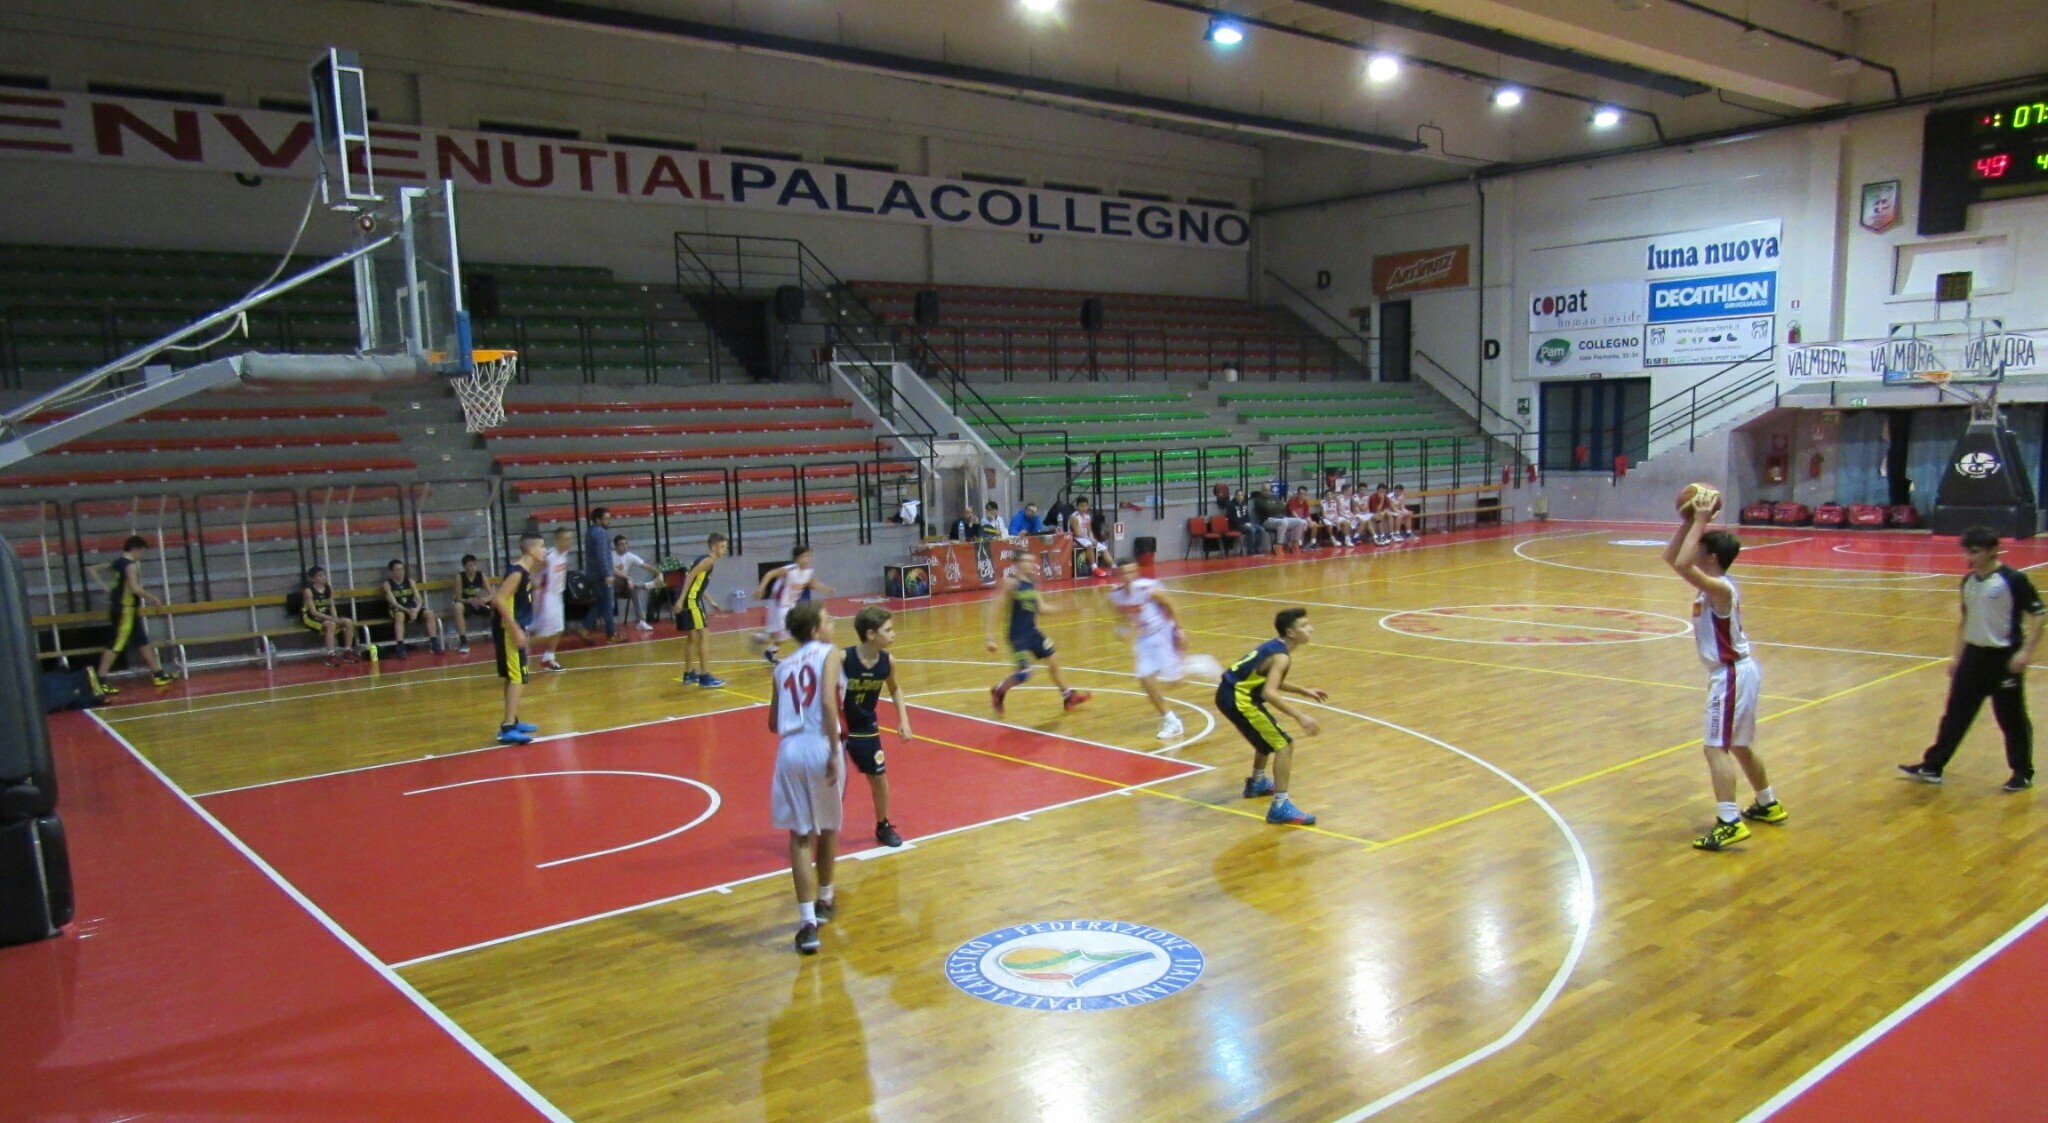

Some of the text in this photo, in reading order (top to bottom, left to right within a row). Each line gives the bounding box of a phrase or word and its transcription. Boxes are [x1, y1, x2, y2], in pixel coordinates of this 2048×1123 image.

[1976, 154, 2008, 176] 49
[1647, 236, 1779, 270] luna nuova
[1317, 270, 1331, 290] D
[1655, 280, 1768, 308] DECATHLON
[1724, 299, 1767, 309] GRUGLIASCO
[1484, 339, 1500, 360] D
[1541, 346, 1565, 357] Pam
[1578, 338, 1639, 350] COLLEGNO
[1787, 348, 1848, 376] VALMORA
[783, 664, 817, 715] 19
[950, 921, 1201, 1010] FEDERAZIONE ITALIANA PALLACANESTRO
